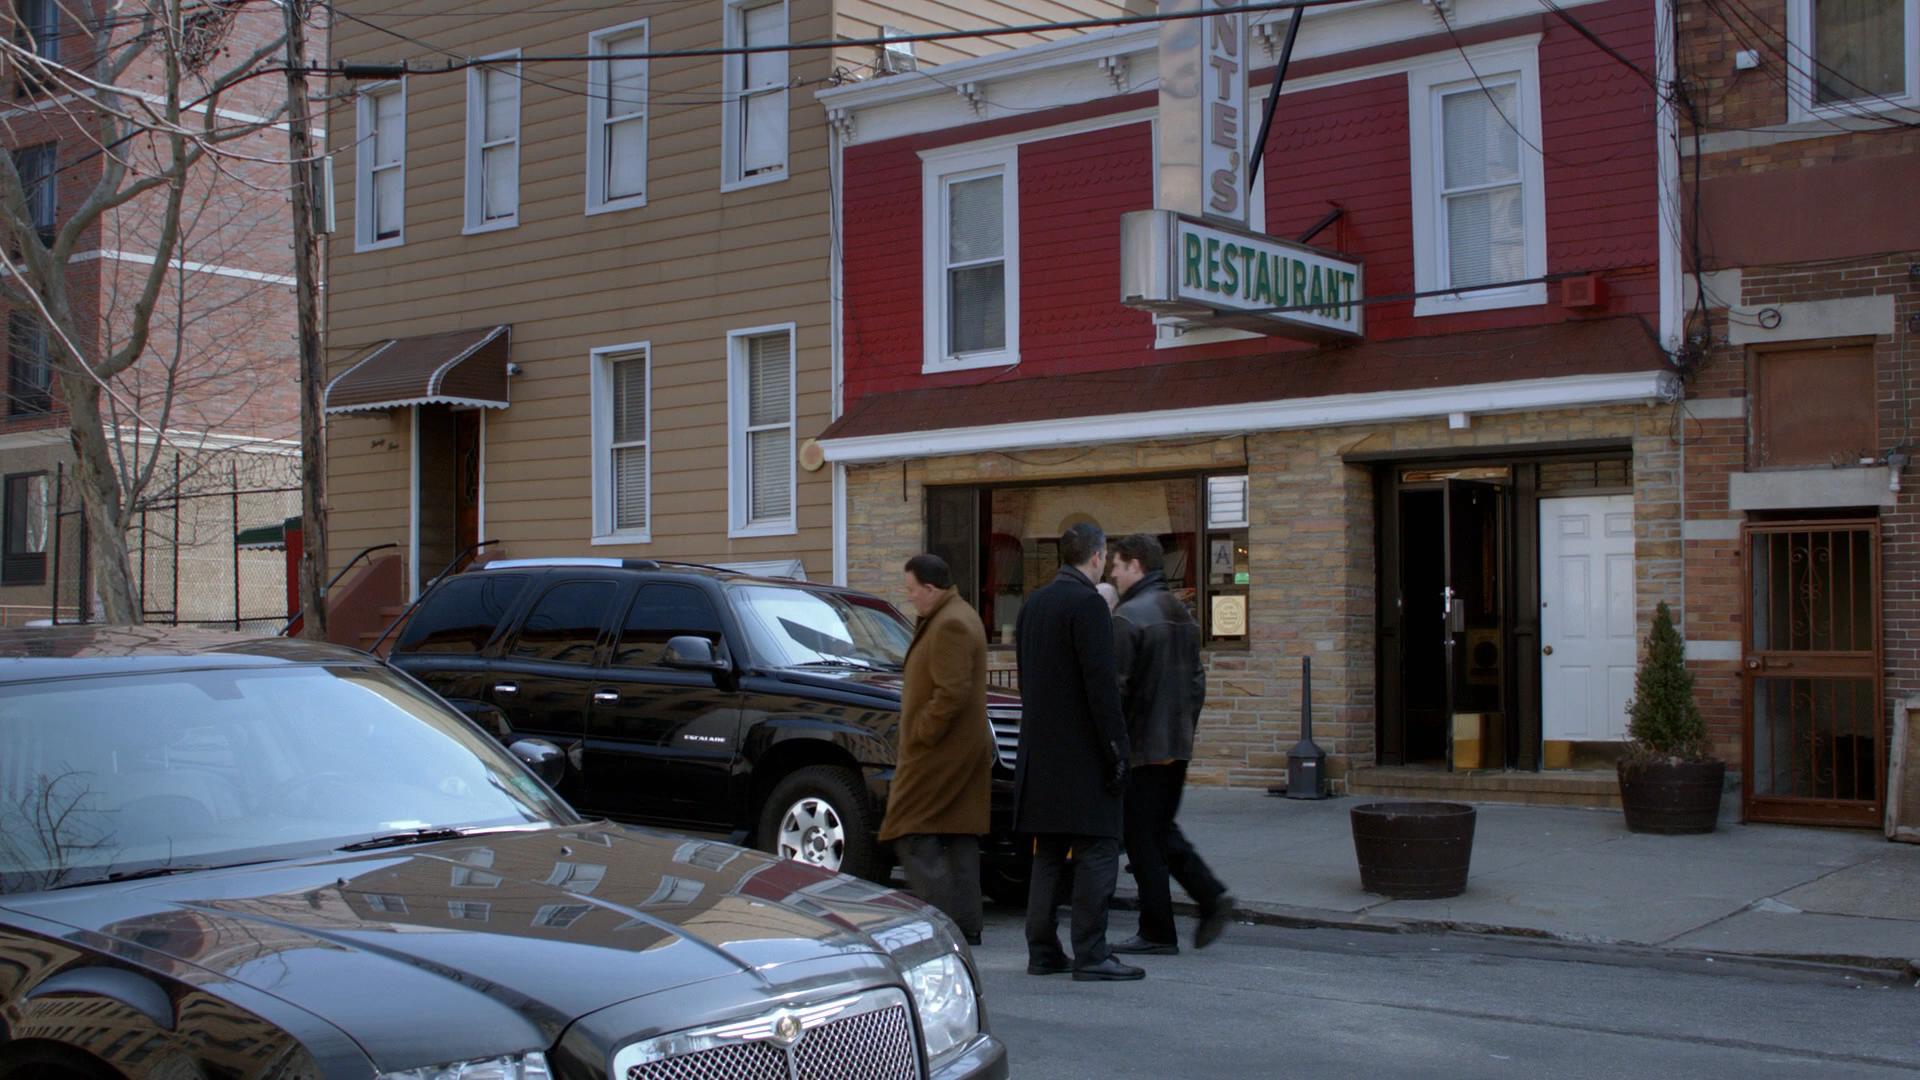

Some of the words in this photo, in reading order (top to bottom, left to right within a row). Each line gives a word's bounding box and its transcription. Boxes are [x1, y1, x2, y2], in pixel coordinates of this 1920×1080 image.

[1209, 0, 1240, 213] NTE'S
[1183, 232, 1355, 322] RESTAURANT
[1215, 544, 1231, 565] A
